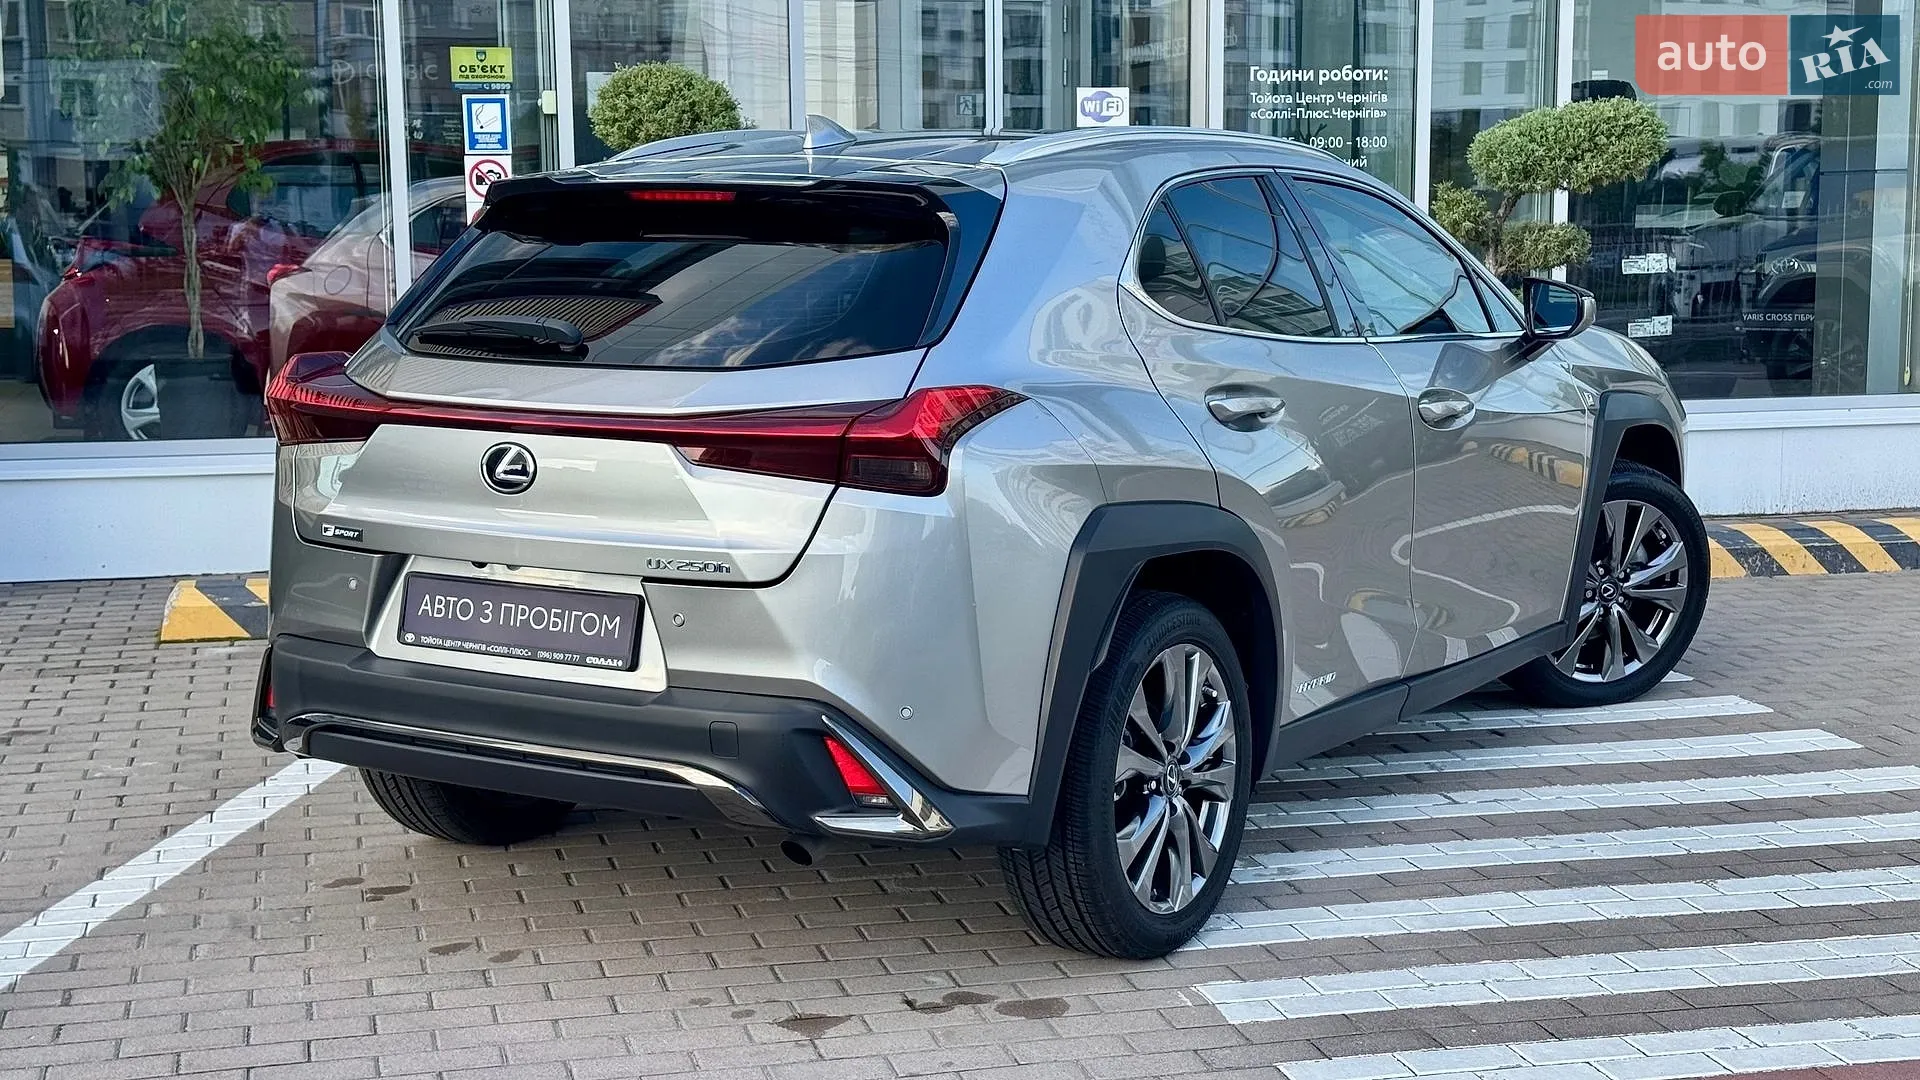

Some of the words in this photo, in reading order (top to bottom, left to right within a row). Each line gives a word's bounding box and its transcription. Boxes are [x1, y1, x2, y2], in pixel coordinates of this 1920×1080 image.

[1250, 66, 1314, 85] Години
[1319, 65, 1389, 85] роботи:
[1250, 92, 1293, 104] Тойота
[1296, 92, 1335, 105] Центр
[1337, 91, 1388, 105] Чернігів
[1250, 107, 1387, 120] «Соллі-Плюс.Чернігів»
[1309, 136, 1344, 149] 09:00
[1355, 136, 1388, 148] 18:00
[1742, 313, 1764, 321] YARIS
[1765, 313, 1793, 321] CROSS
[334, 528, 359, 538] SPORT
[645, 558, 674, 571] UX
[676, 559, 731, 574] 250h
[418, 593, 474, 621] АВТО
[499, 602, 621, 639] ПРОБІГОМ
[420, 636, 443, 646] ТОЙОТА
[443, 639, 461, 648] ЦЕНТР
[462, 641, 486, 651] ЧЕРНІГІВ
